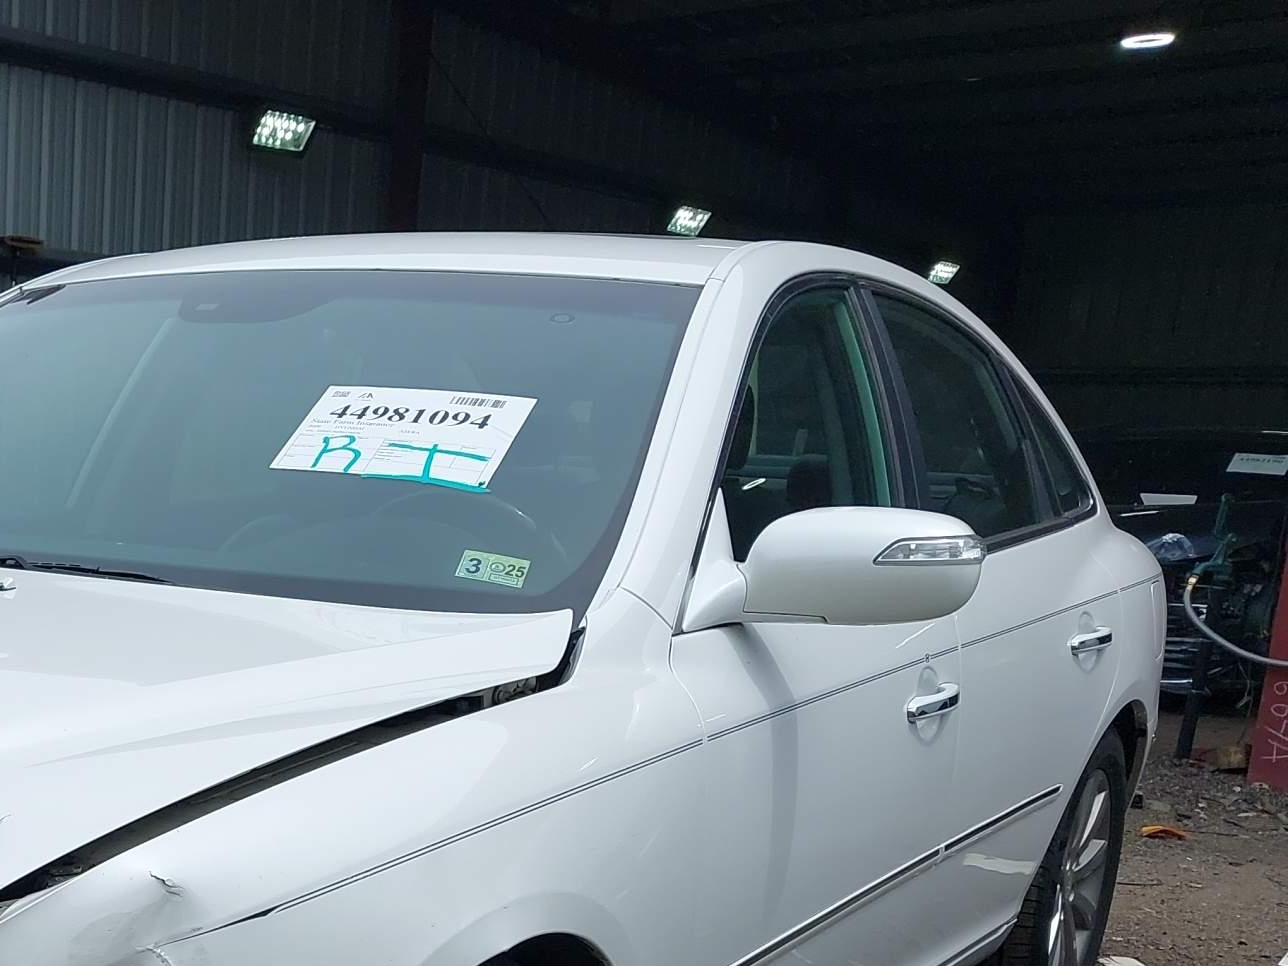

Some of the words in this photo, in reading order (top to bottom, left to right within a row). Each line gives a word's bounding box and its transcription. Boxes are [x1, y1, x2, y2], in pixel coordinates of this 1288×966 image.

[329, 404, 493, 430] 44981094
[465, 558, 482, 574] 3
[504, 564, 527, 578] 25
